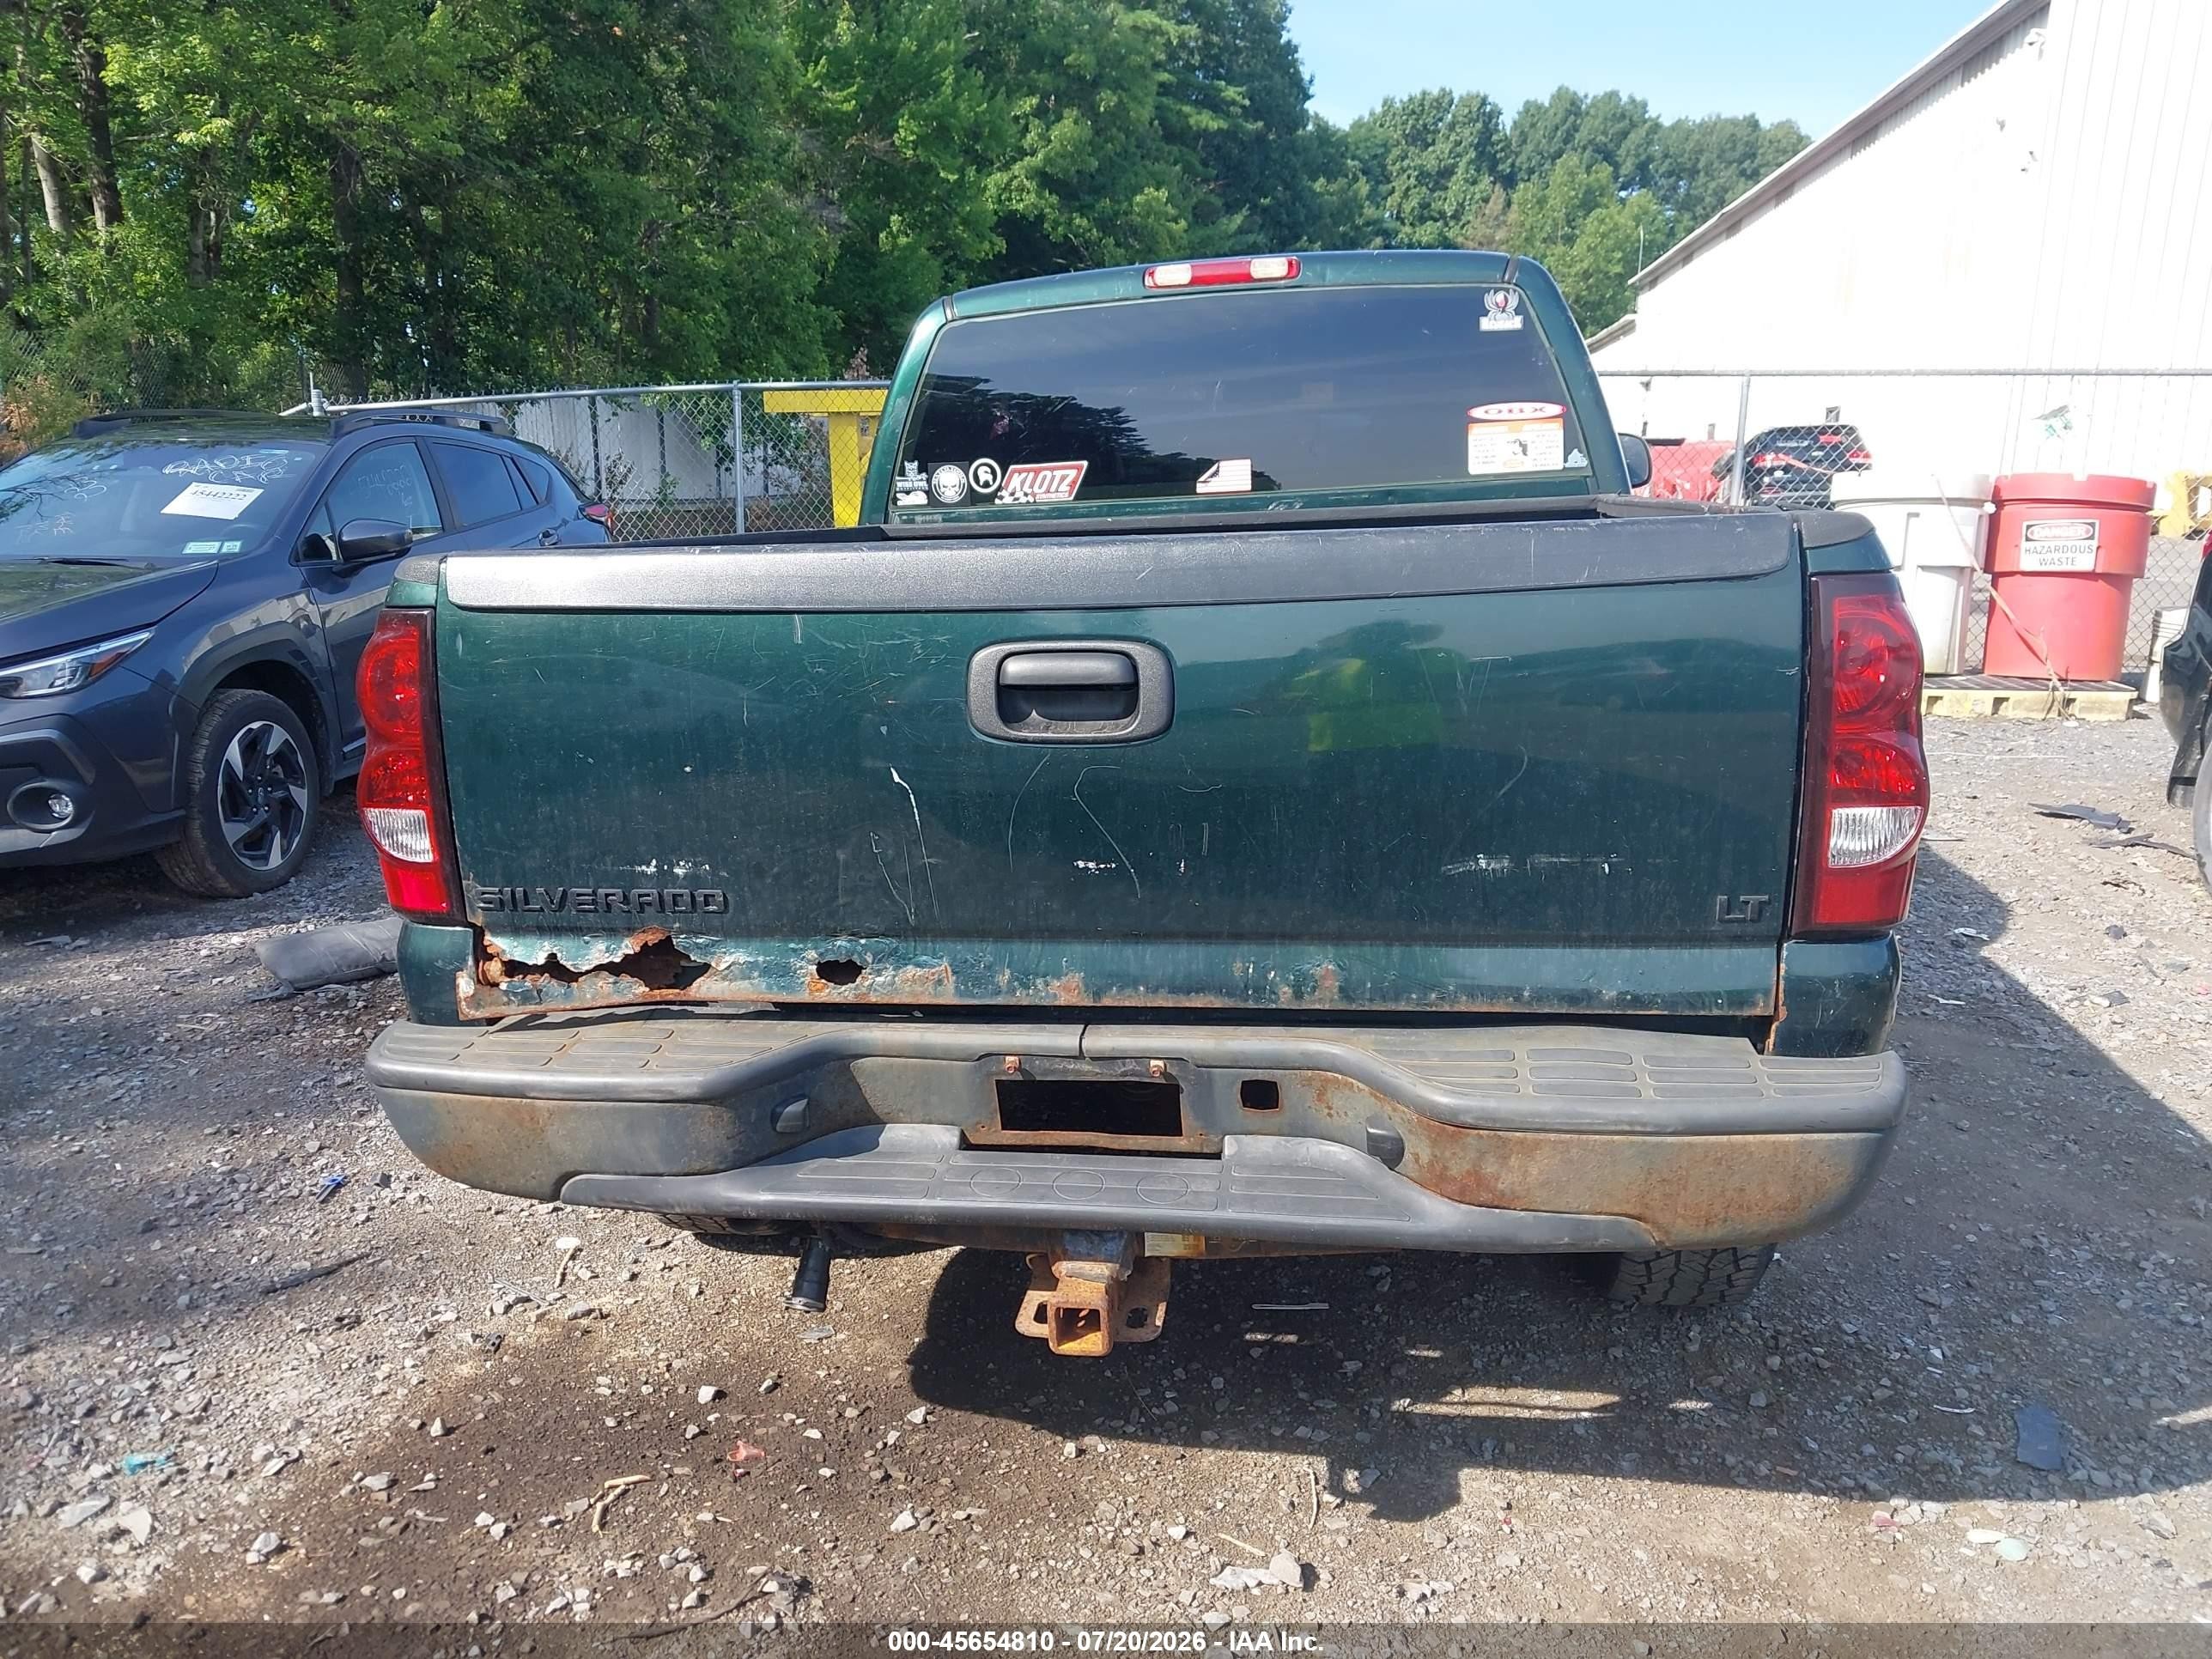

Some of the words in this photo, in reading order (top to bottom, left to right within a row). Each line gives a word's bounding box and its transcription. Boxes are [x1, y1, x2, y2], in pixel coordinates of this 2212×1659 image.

[1006, 469, 1079, 494] KLOTZ
[2031, 526, 2087, 538] DANGER
[2025, 544, 2094, 555] HAZARDOUS
[2039, 556, 2077, 567] WASTE
[475, 887, 730, 914] SILVERADO
[1717, 895, 1770, 921] LT
